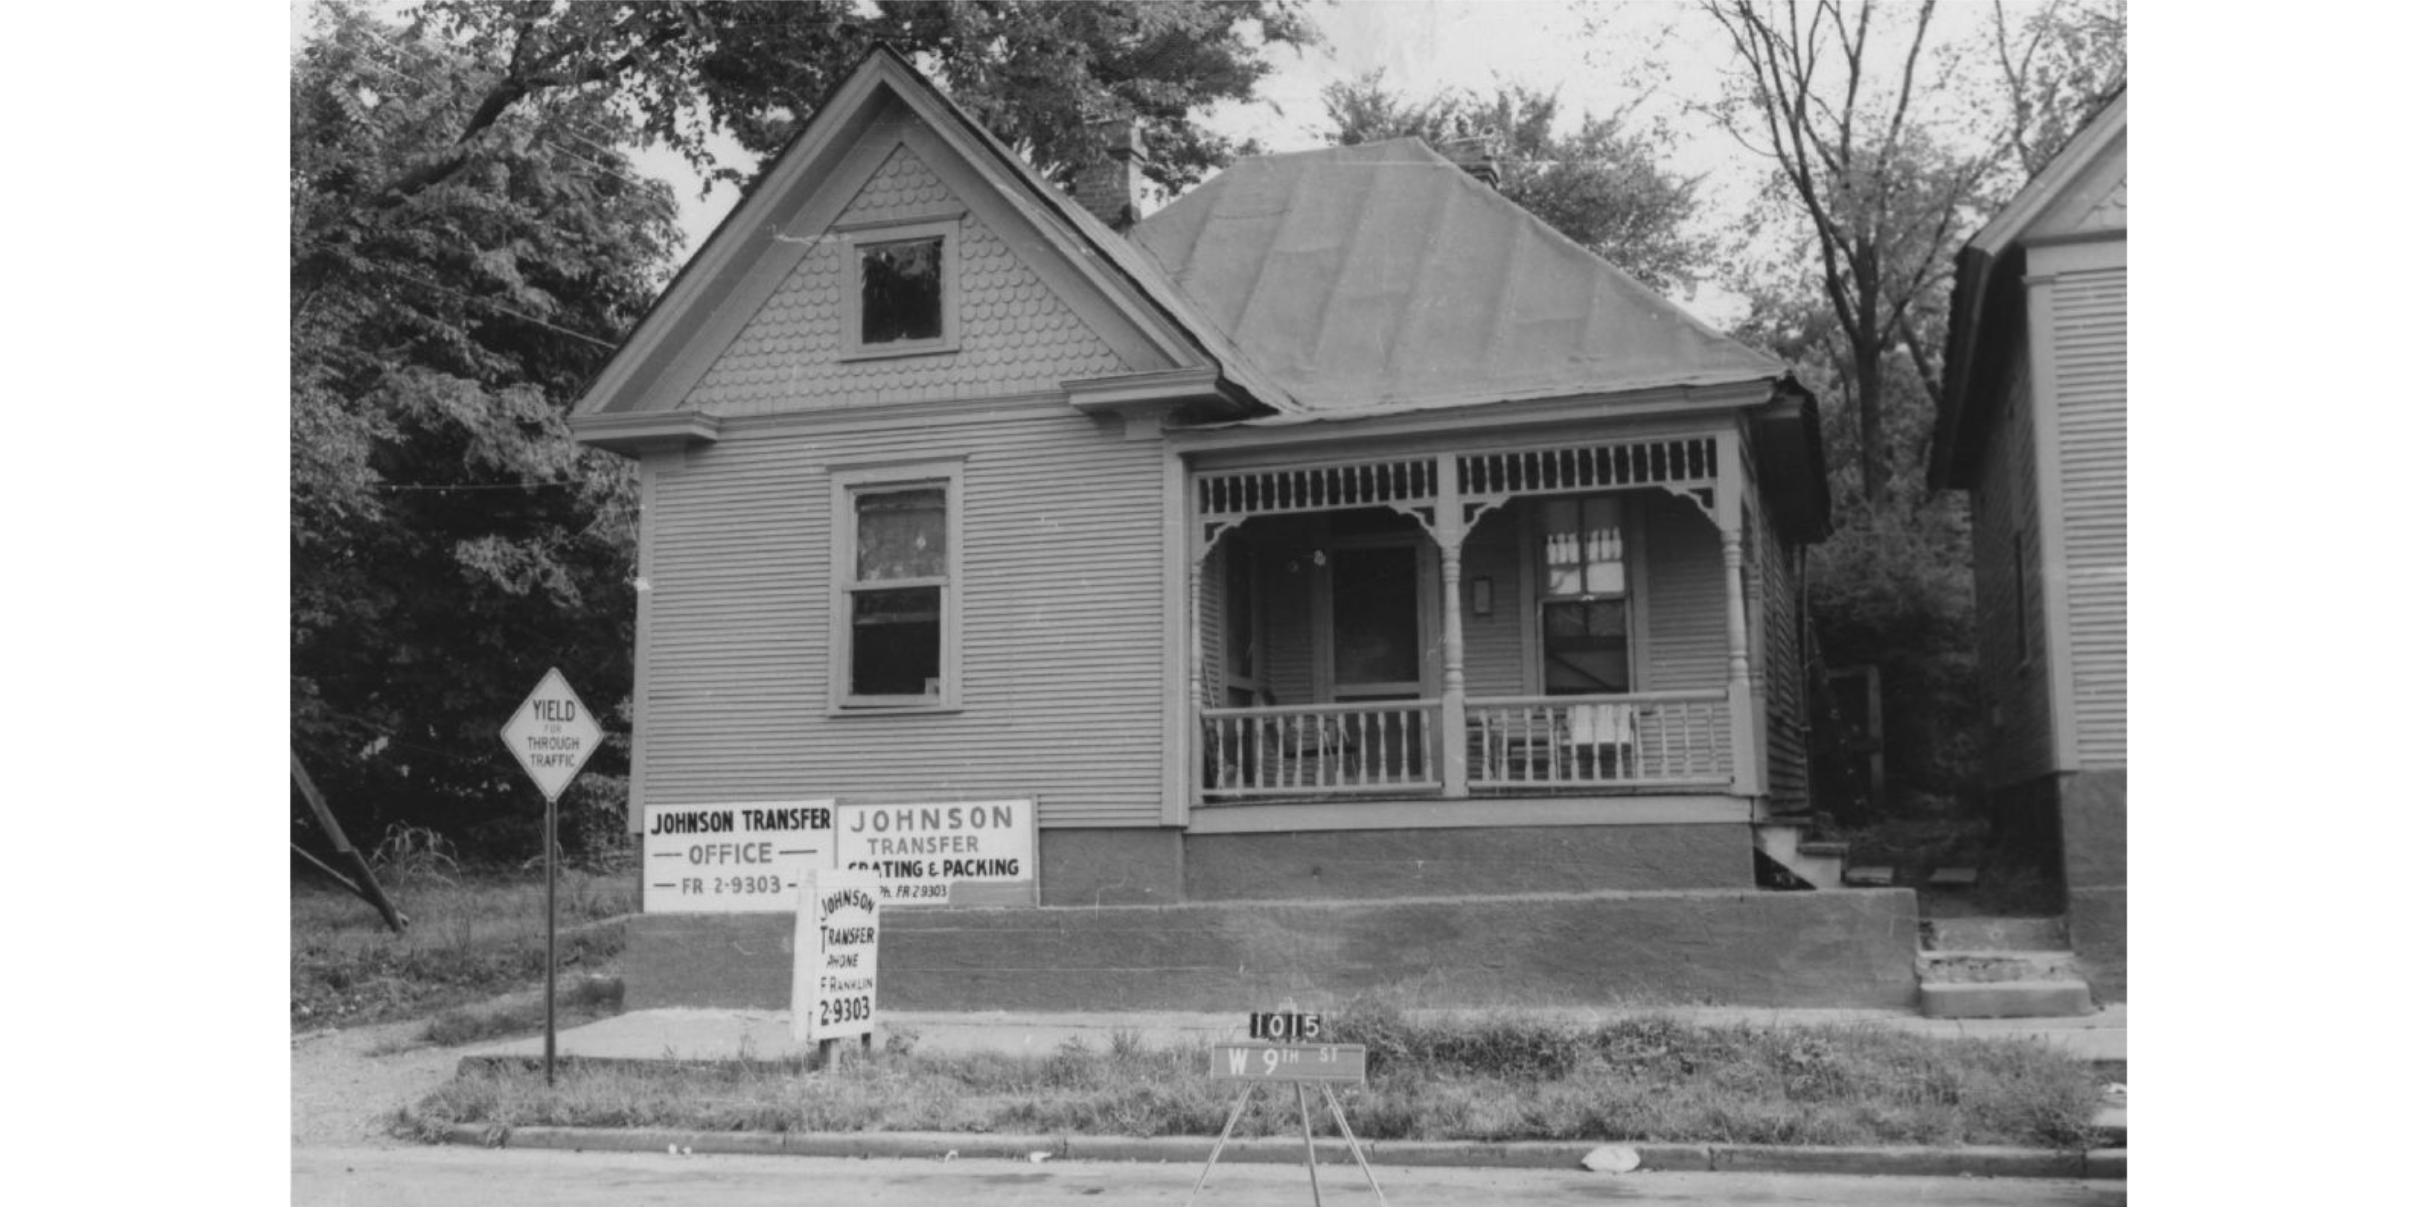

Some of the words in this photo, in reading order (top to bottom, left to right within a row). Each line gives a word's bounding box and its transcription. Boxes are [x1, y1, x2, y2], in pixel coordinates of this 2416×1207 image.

[533, 700, 575, 722] YIELD
[528, 736, 580, 750] THROUGH
[530, 754, 575, 767] TRAFFIC
[651, 810, 734, 835] JOHNSON
[742, 807, 831, 831] TRANSFER
[850, 806, 1012, 833] JOHNSON
[689, 842, 772, 865] OFFICE
[867, 835, 979, 855] TRANSFER
[929, 862, 940, 877] &
[943, 858, 1019, 877] PACKING
[682, 877, 704, 895] FR
[821, 889, 875, 921] JOHNSON
[820, 925, 875, 954] TRANSFER
[828, 953, 859, 968] PHONE
[821, 975, 873, 994] FRANKLIN
[1256, 1014, 1319, 1037] 1015
[1228, 1047, 1249, 1076] W
[1319, 1046, 1338, 1062] ST
